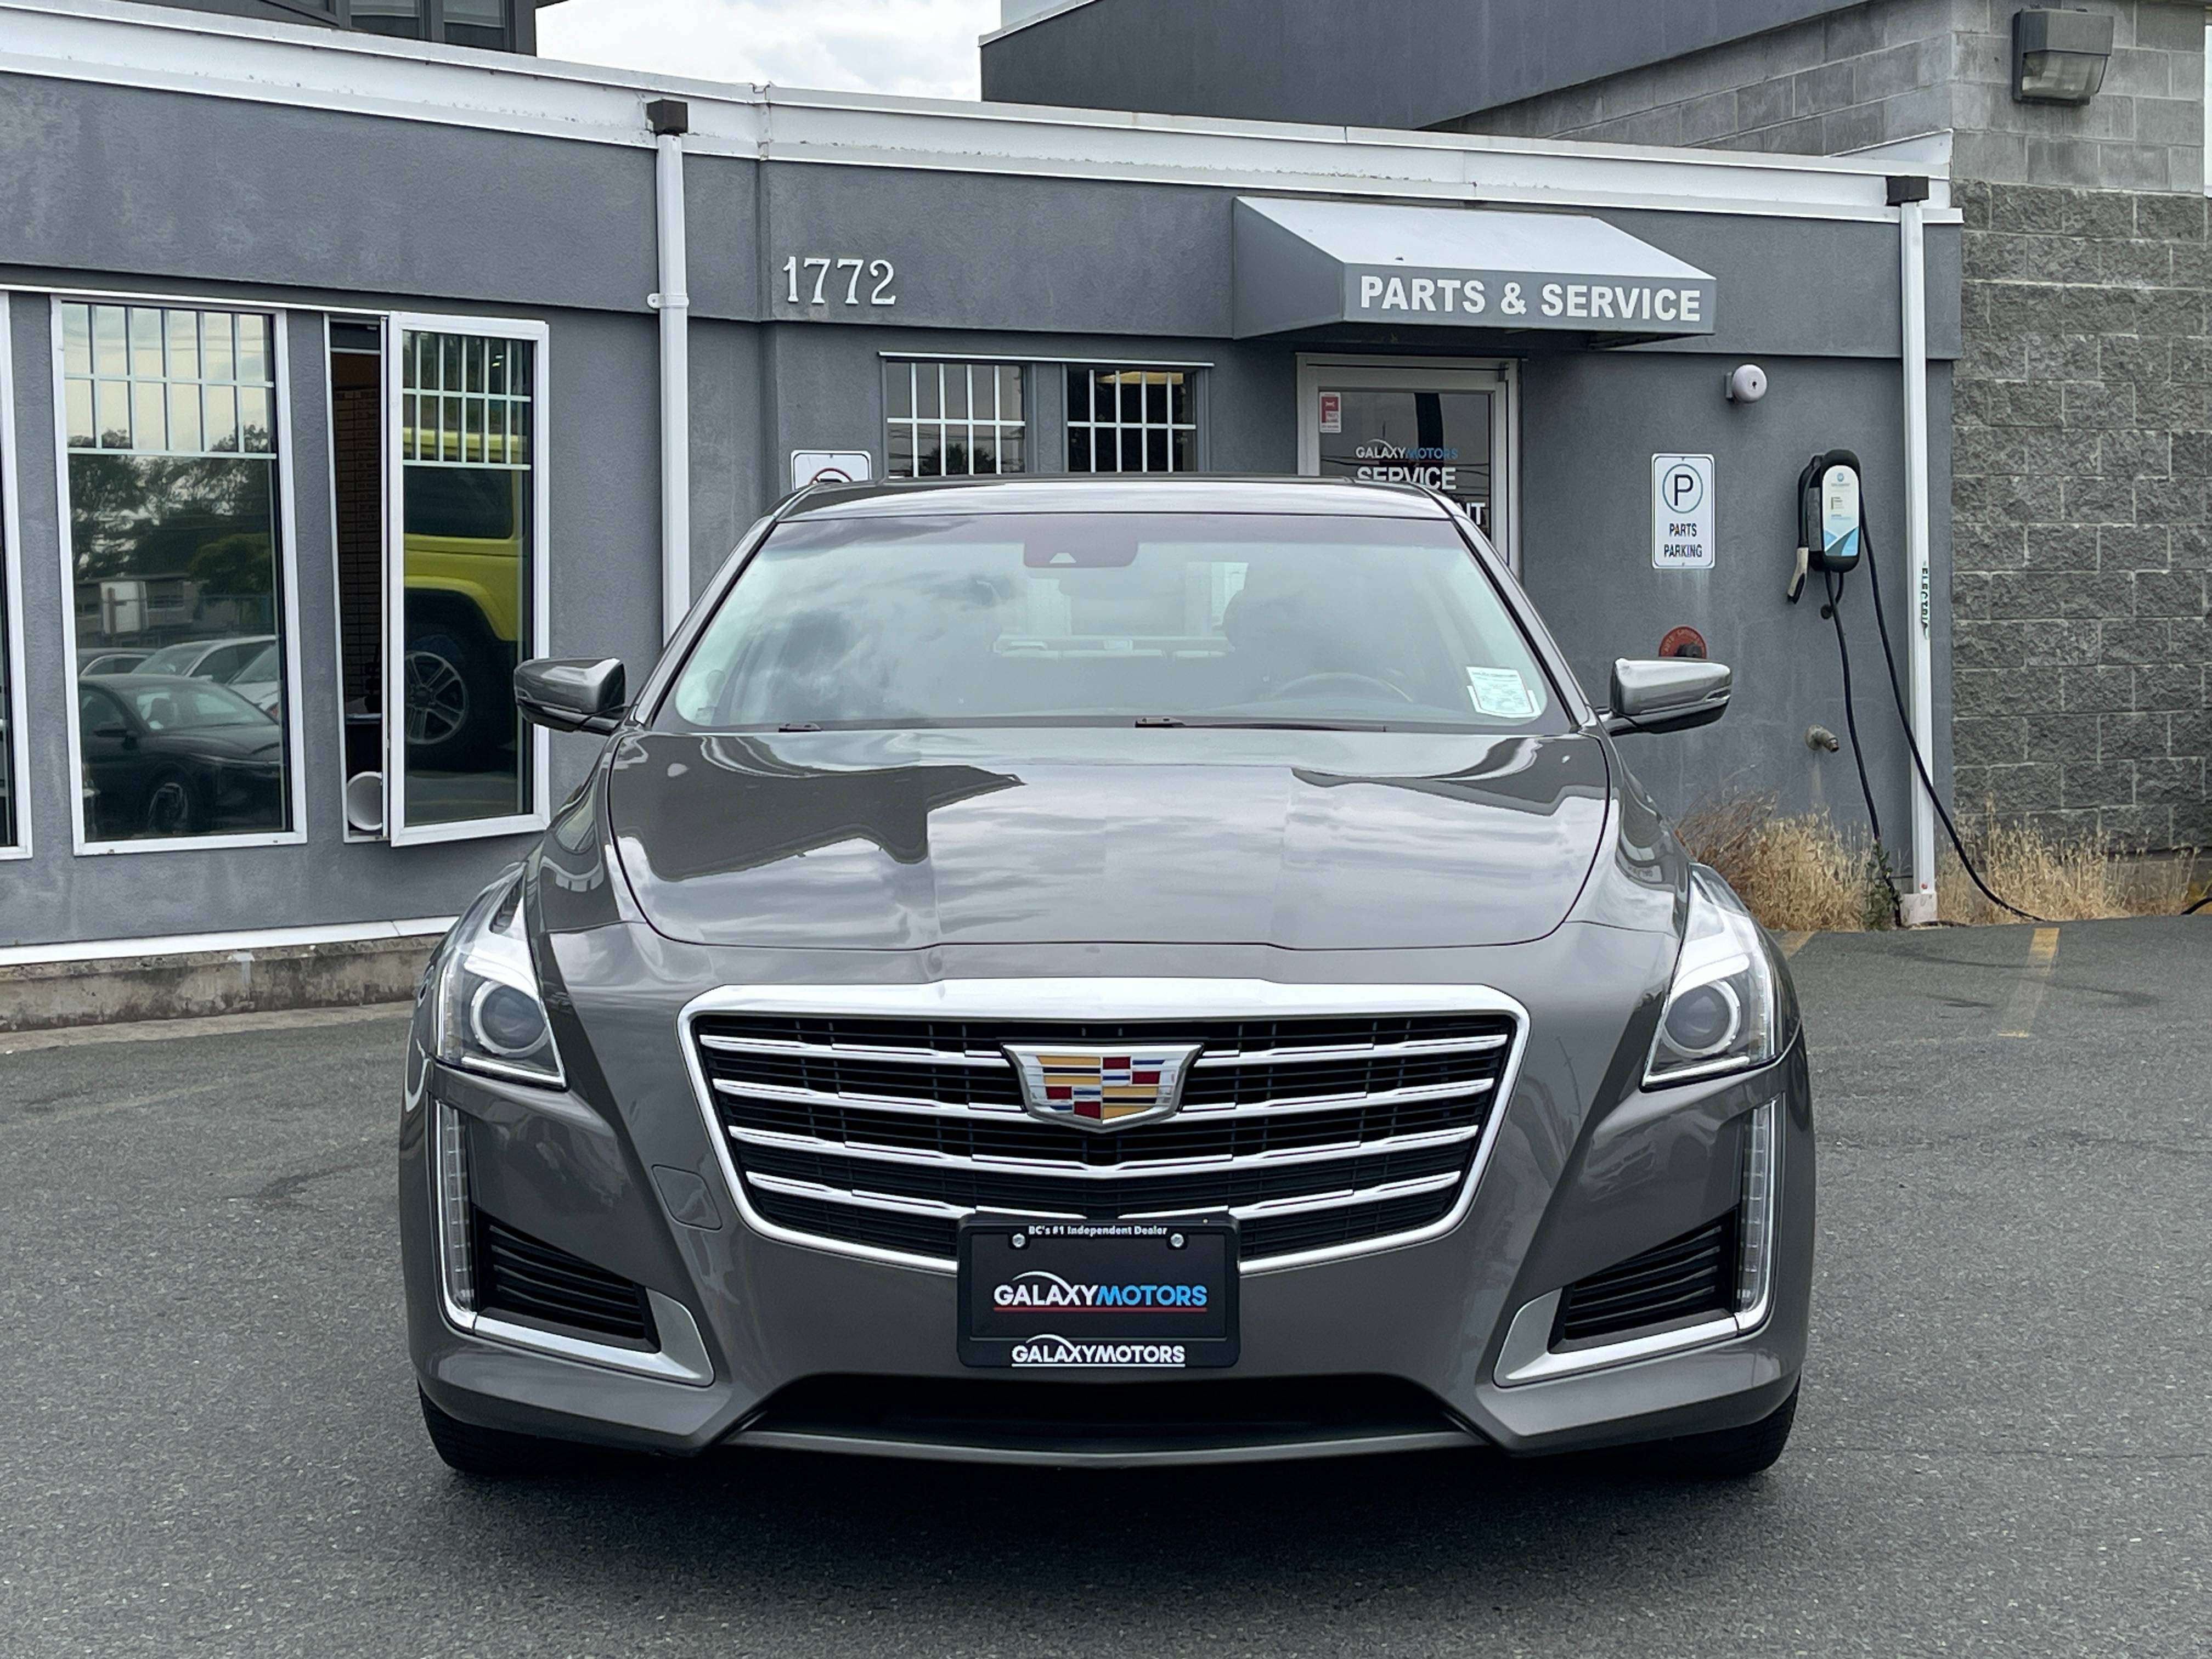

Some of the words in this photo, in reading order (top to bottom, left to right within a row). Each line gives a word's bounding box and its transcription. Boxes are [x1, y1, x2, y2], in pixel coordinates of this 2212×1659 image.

[783, 256, 896, 305] 1772
[1361, 275, 1486, 314] PARTS
[1500, 282, 1527, 315] &
[1541, 283, 1701, 322] SERVICE
[1356, 445, 1458, 459] GALAXYMOTORS
[1357, 466, 1457, 490] SERVICE
[1674, 473, 1694, 506] P
[1669, 522, 1697, 538] PARTS
[1664, 544, 1703, 558] PARKING
[1028, 1225, 1051, 1235] BC's
[1052, 1225, 1064, 1235] #1
[1067, 1225, 1132, 1237] Independent
[1133, 1225, 1168, 1235] Dealer
[993, 1284, 1207, 1306] GALAXYMOTORS
[1011, 1345, 1186, 1363] GALAXYMOTORS
